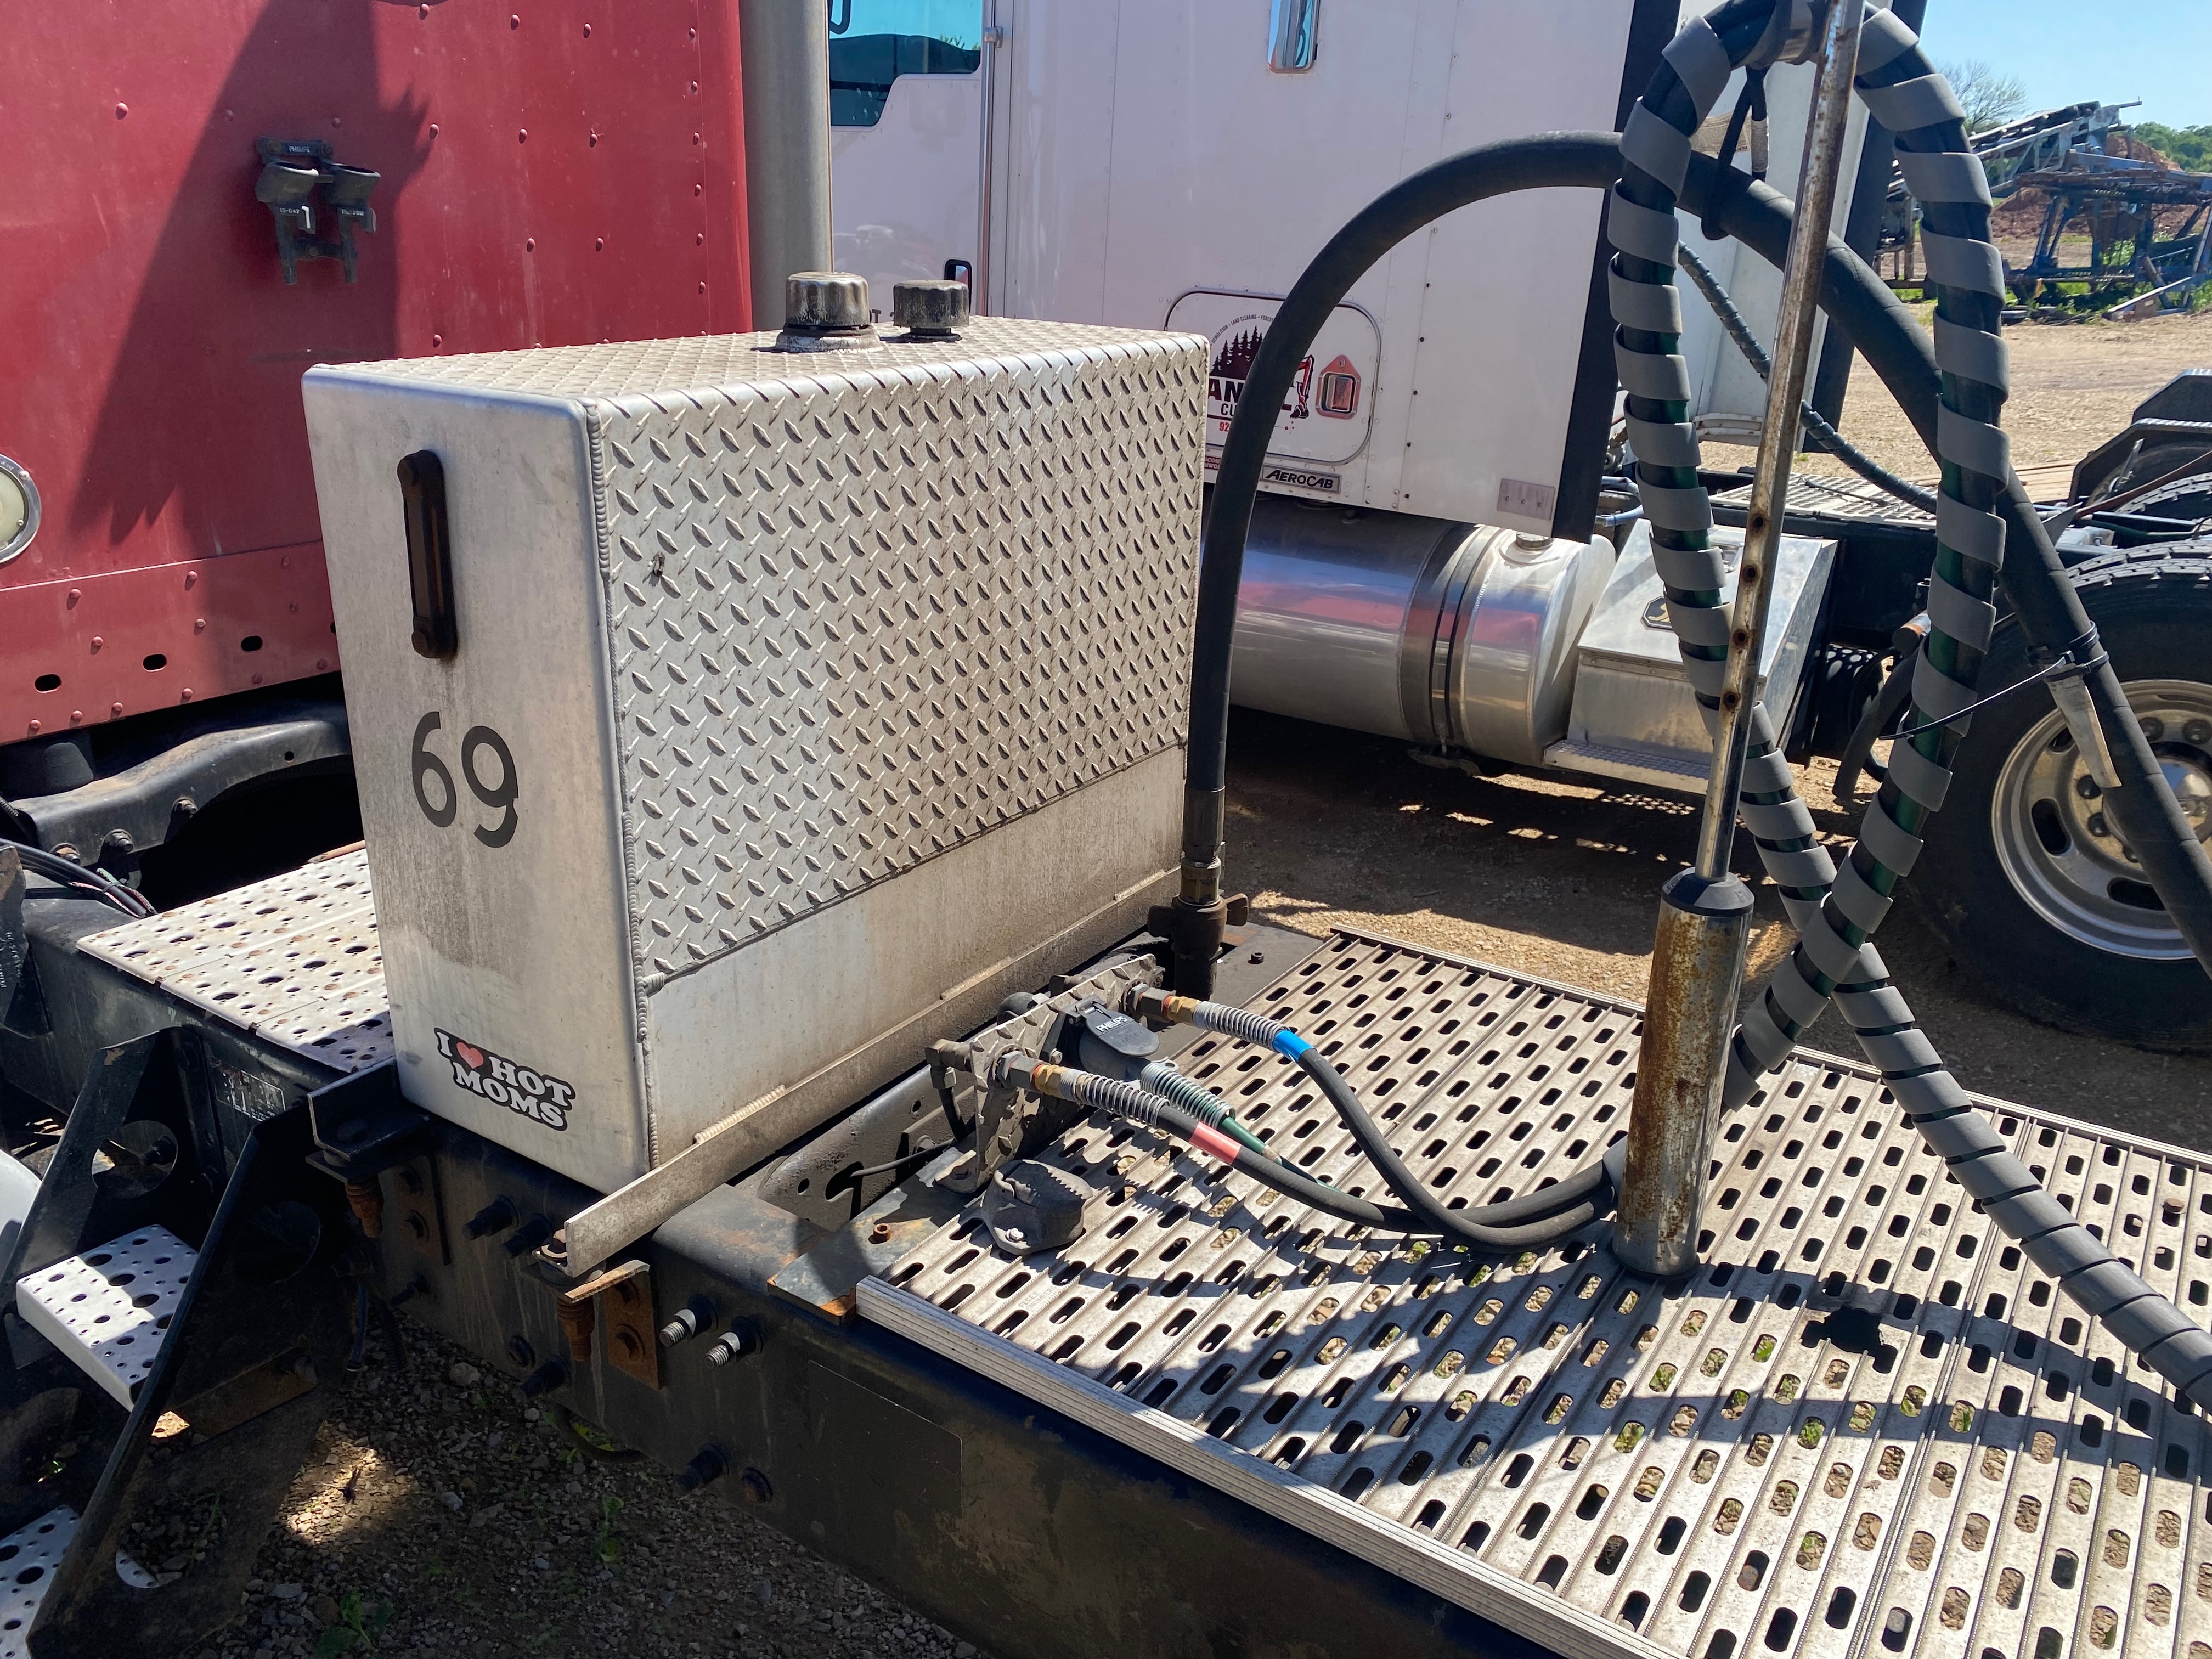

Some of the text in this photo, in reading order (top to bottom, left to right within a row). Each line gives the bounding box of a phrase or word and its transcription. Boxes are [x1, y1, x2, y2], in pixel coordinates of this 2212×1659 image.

[1211, 324, 1228, 343] DEMOLITION
[1231, 318, 1240, 326] LAND
[1265, 470, 1334, 489] AEROCAB
[412, 711, 518, 848] 69
[1096, 1015, 1128, 1033] PHILLIPS
[437, 1032, 572, 1106] I HOT
[453, 1062, 563, 1127] MOMS
